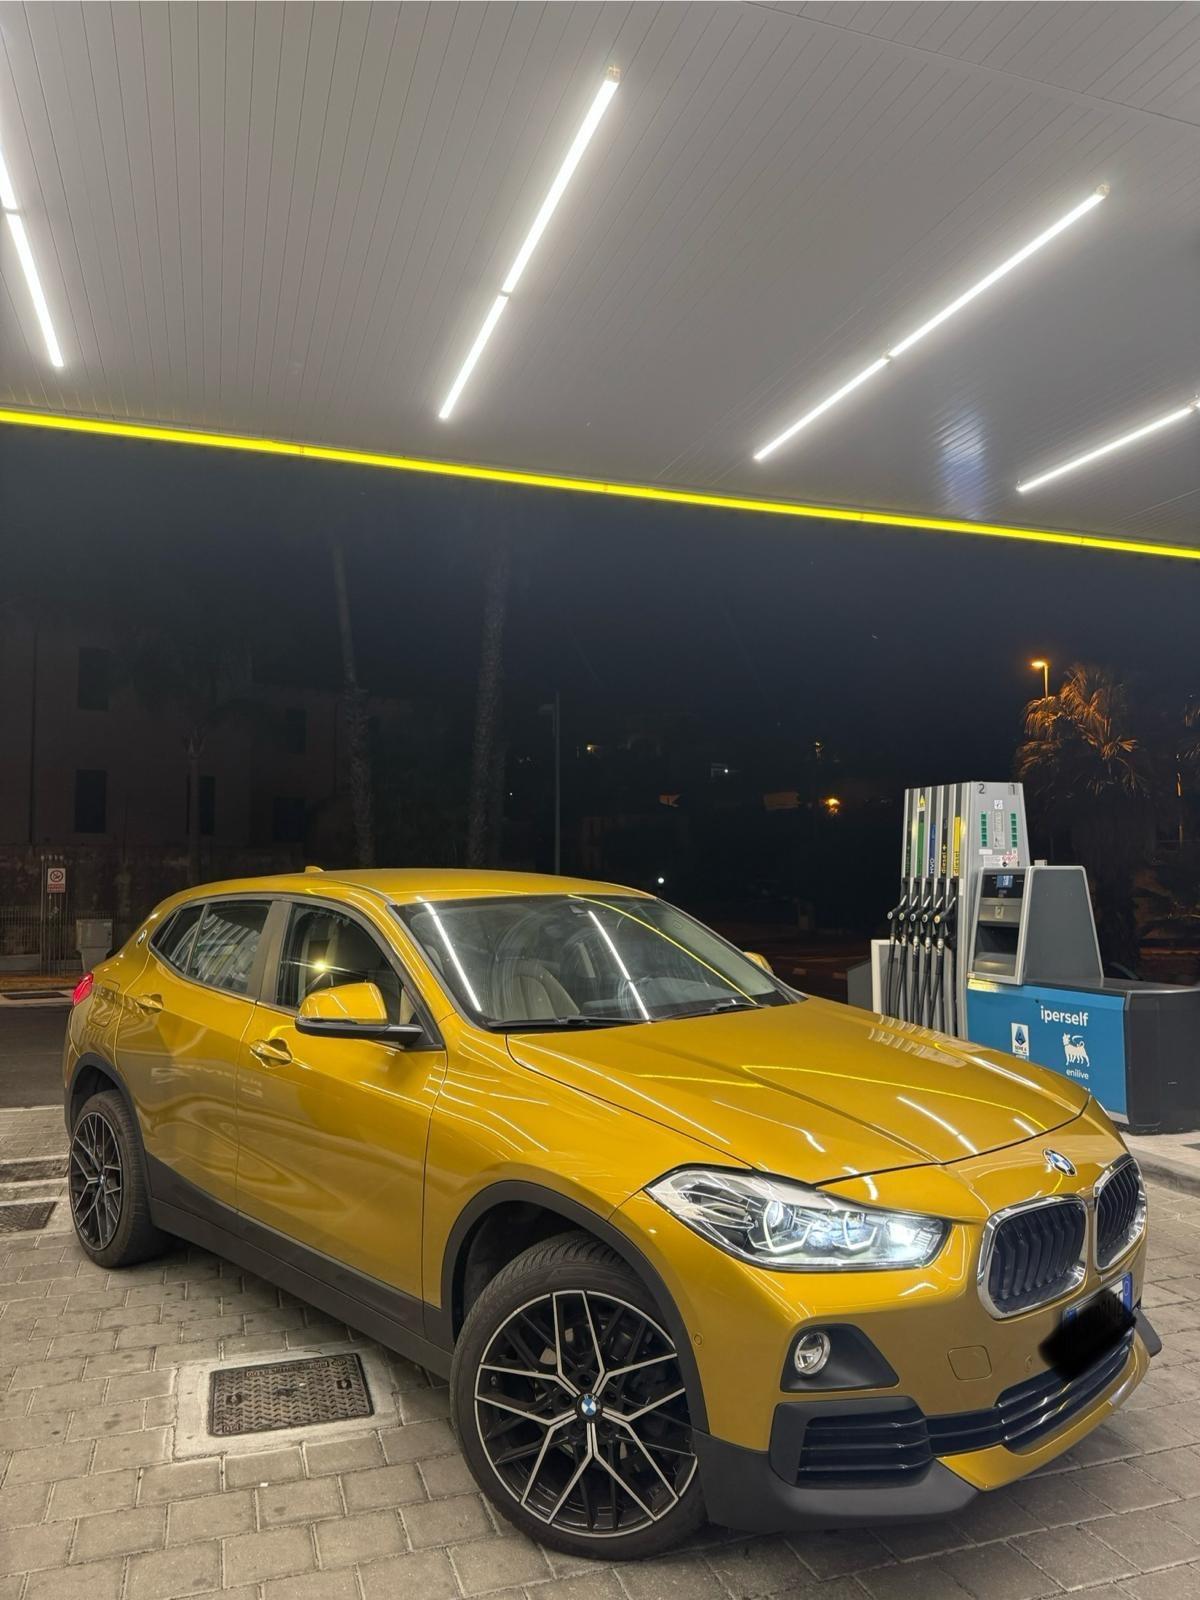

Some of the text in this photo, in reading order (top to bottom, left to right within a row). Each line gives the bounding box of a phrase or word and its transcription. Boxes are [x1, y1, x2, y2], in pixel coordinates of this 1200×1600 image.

[978, 783, 985, 794] 2
[1040, 1005, 1088, 1026] iperself
[1066, 1068, 1089, 1080] enilive
